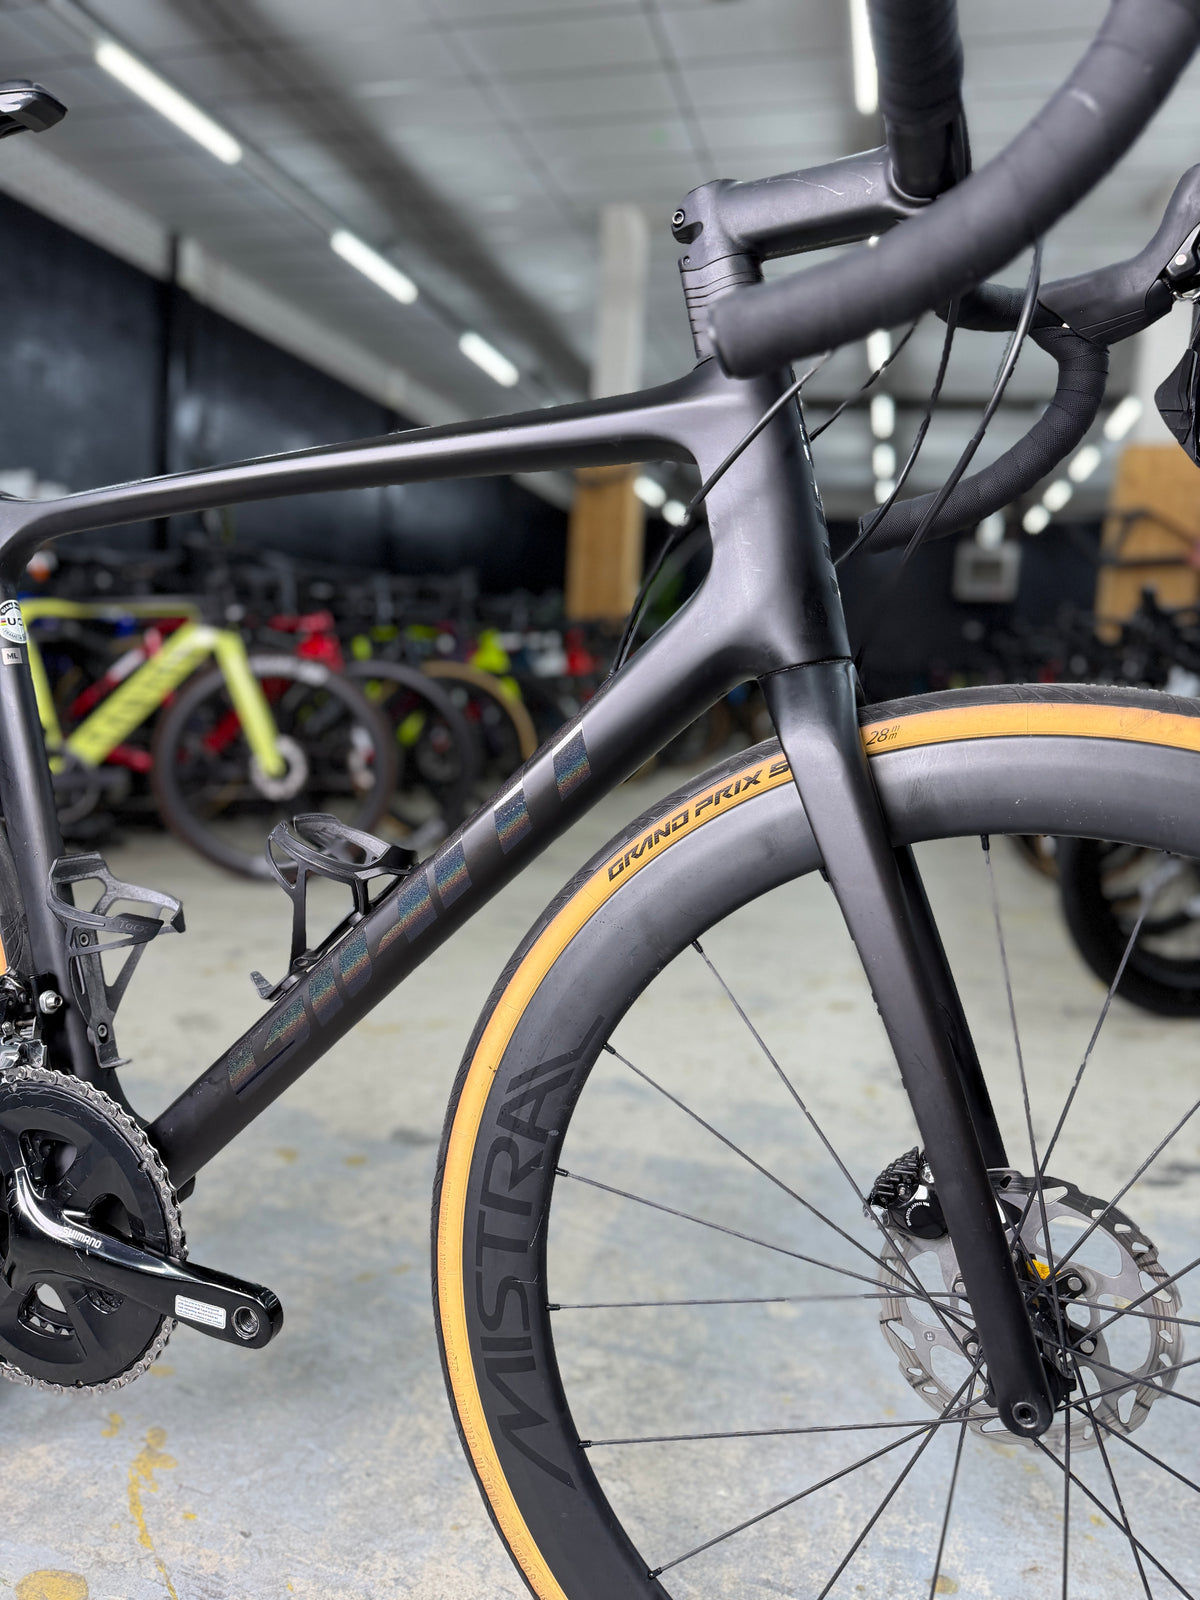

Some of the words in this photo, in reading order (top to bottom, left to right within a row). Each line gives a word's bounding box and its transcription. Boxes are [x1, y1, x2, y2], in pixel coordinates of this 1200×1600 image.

[608, 809, 690, 882] GRAND
[694, 769, 763, 818] PRIX
[62, 1226, 103, 1249] SHIMANO
[475, 1013, 605, 1491] MISTRAL
